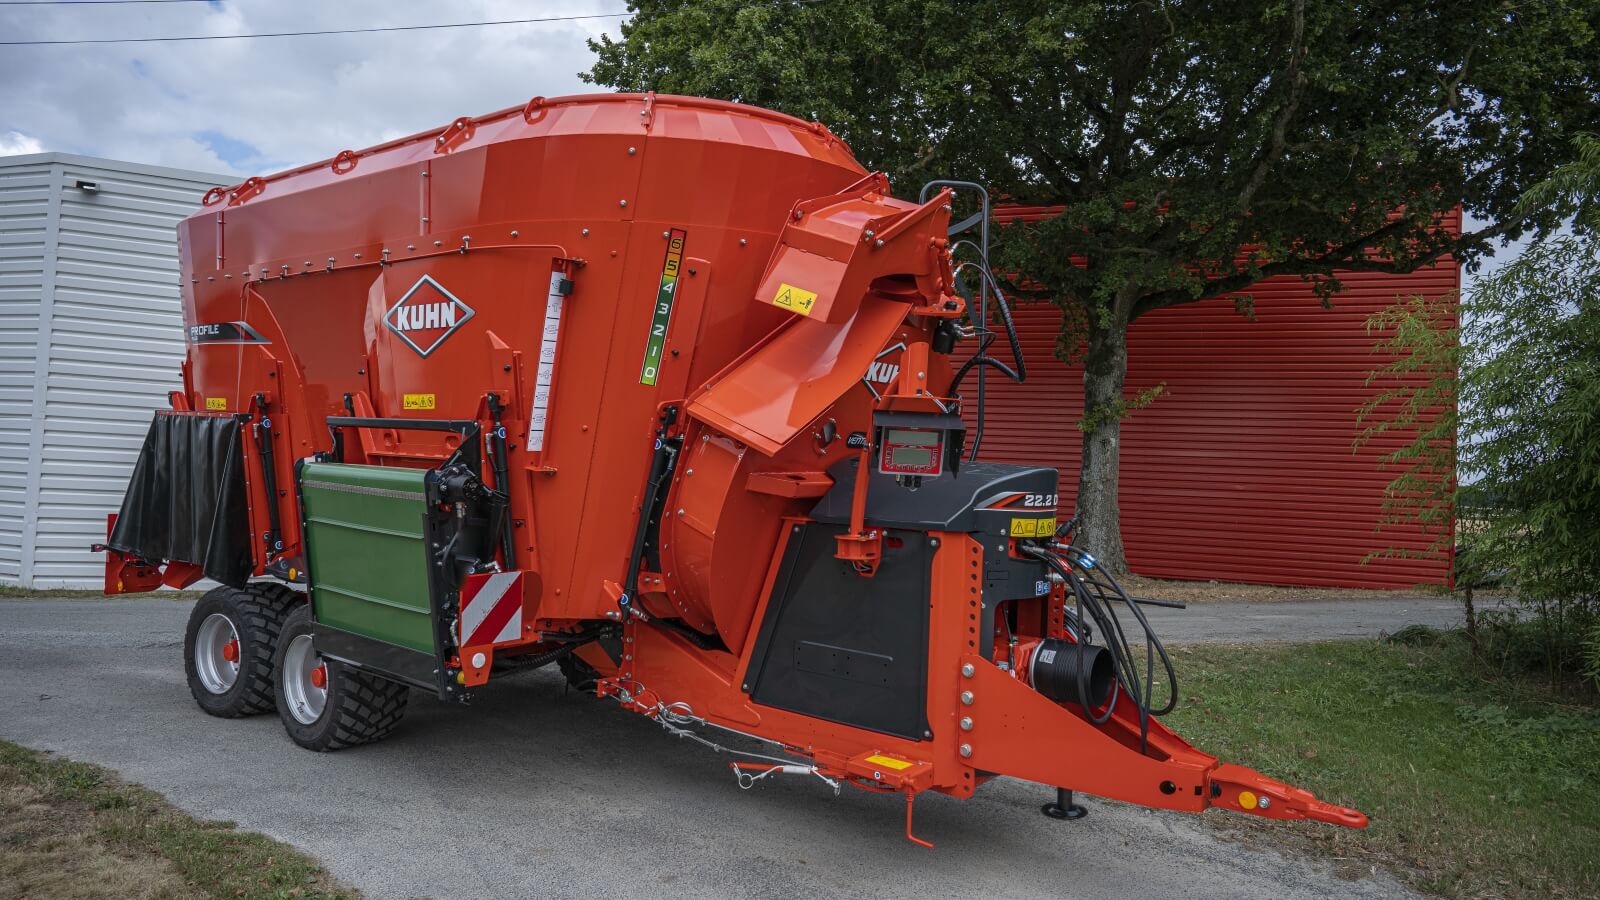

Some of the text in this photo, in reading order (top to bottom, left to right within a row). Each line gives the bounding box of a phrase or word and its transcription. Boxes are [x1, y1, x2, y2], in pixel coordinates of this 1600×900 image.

[671, 238, 681, 250] 6
[666, 260, 678, 271] 5
[662, 282, 674, 294] 4
[657, 303, 669, 315] 3
[397, 301, 456, 331] KUHN
[190, 324, 220, 337] PROFILE
[653, 324, 665, 337] 2
[651, 346, 657, 357] 1
[644, 366, 656, 378] 0
